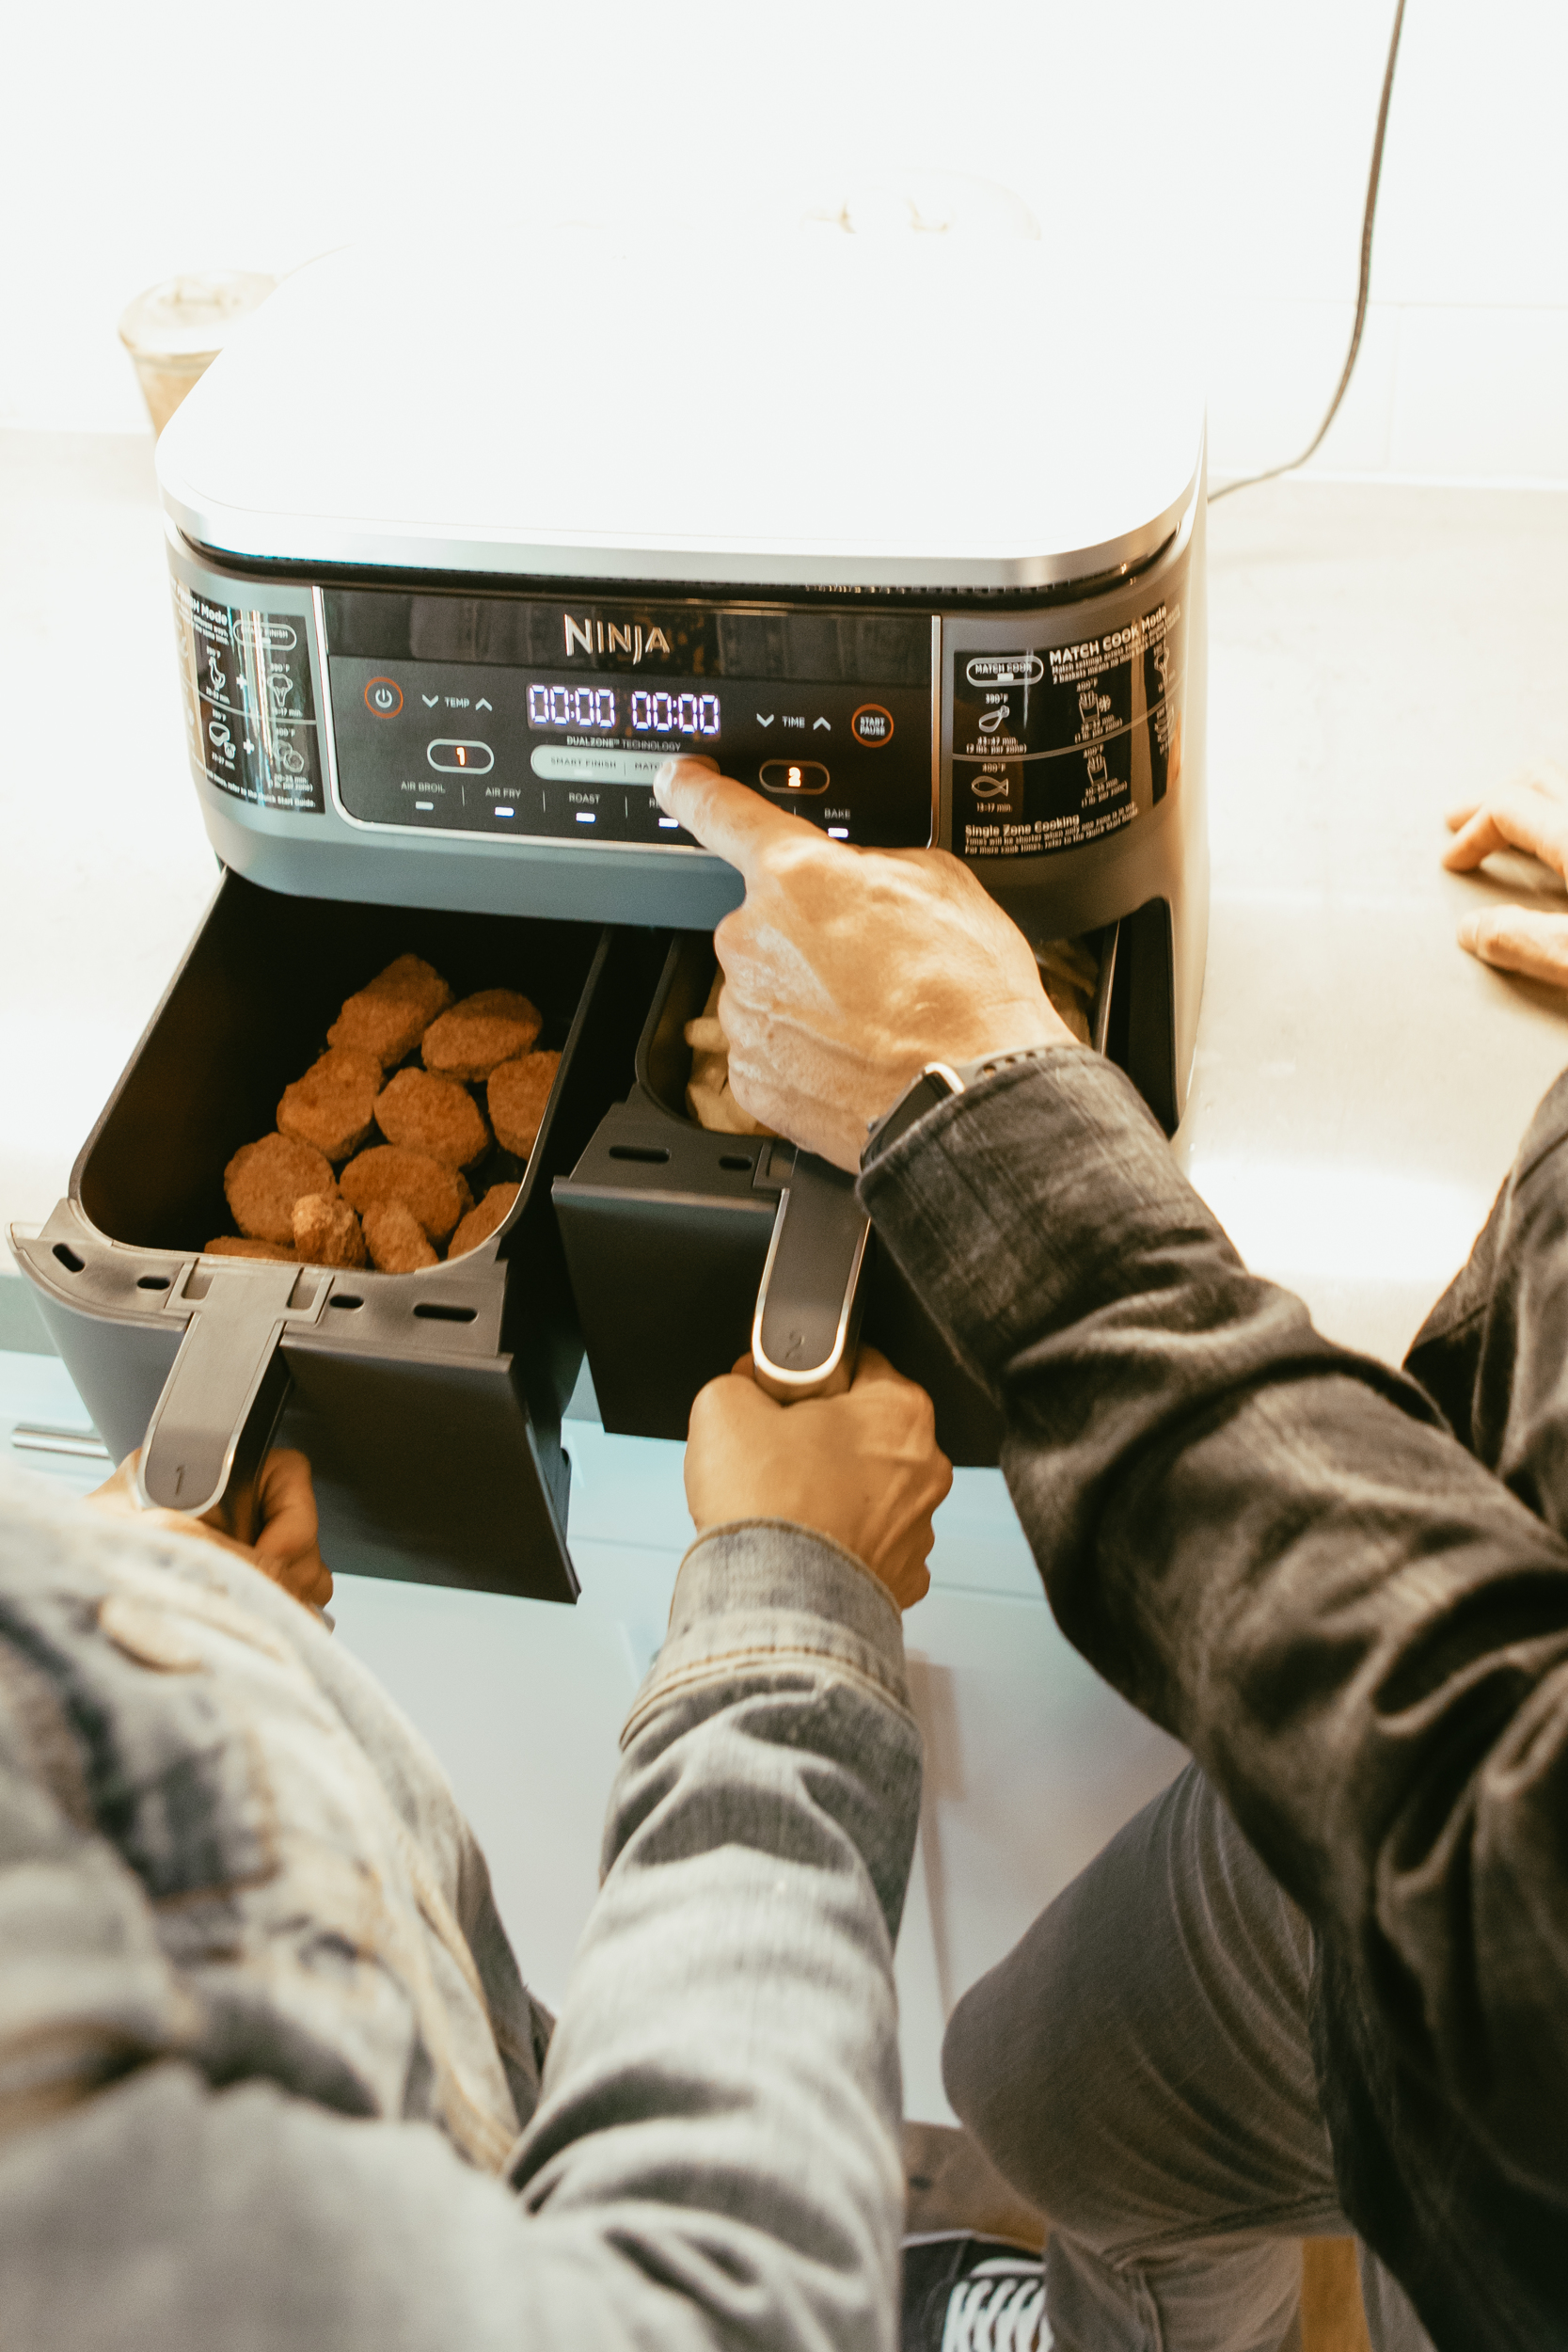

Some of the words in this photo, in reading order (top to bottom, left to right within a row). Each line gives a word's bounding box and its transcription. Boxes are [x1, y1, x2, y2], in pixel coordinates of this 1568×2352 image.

[200, 602, 228, 627] Mode
[564, 613, 671, 665] NINJA
[1049, 640, 1100, 666] MATCH
[1102, 622, 1140, 652] COOK
[1141, 605, 1167, 634] Mode
[974, 663, 1006, 675] MATCH
[444, 696, 470, 708] TEMP
[529, 684, 615, 729] 00:00
[630, 691, 721, 736] 00:00
[782, 715, 805, 728] TIME
[860, 716, 885, 725] START
[860, 725, 886, 736] PAUSE
[621, 739, 681, 752] TECHNOLOGY
[455, 746, 467, 767] 1
[550, 756, 582, 765] SMART
[585, 758, 617, 769] FINISH
[634, 761, 663, 771] MATC
[787, 766, 801, 787] 2
[401, 781, 417, 791] AIR
[418, 782, 446, 794] BROIL
[485, 787, 501, 798] AIR
[502, 787, 522, 800] FRY
[568, 792, 601, 804] ROAST
[824, 807, 851, 820] BAKE
[965, 824, 1000, 839] Single
[1003, 823, 1032, 837] Zone
[1034, 815, 1080, 834] Cooking
